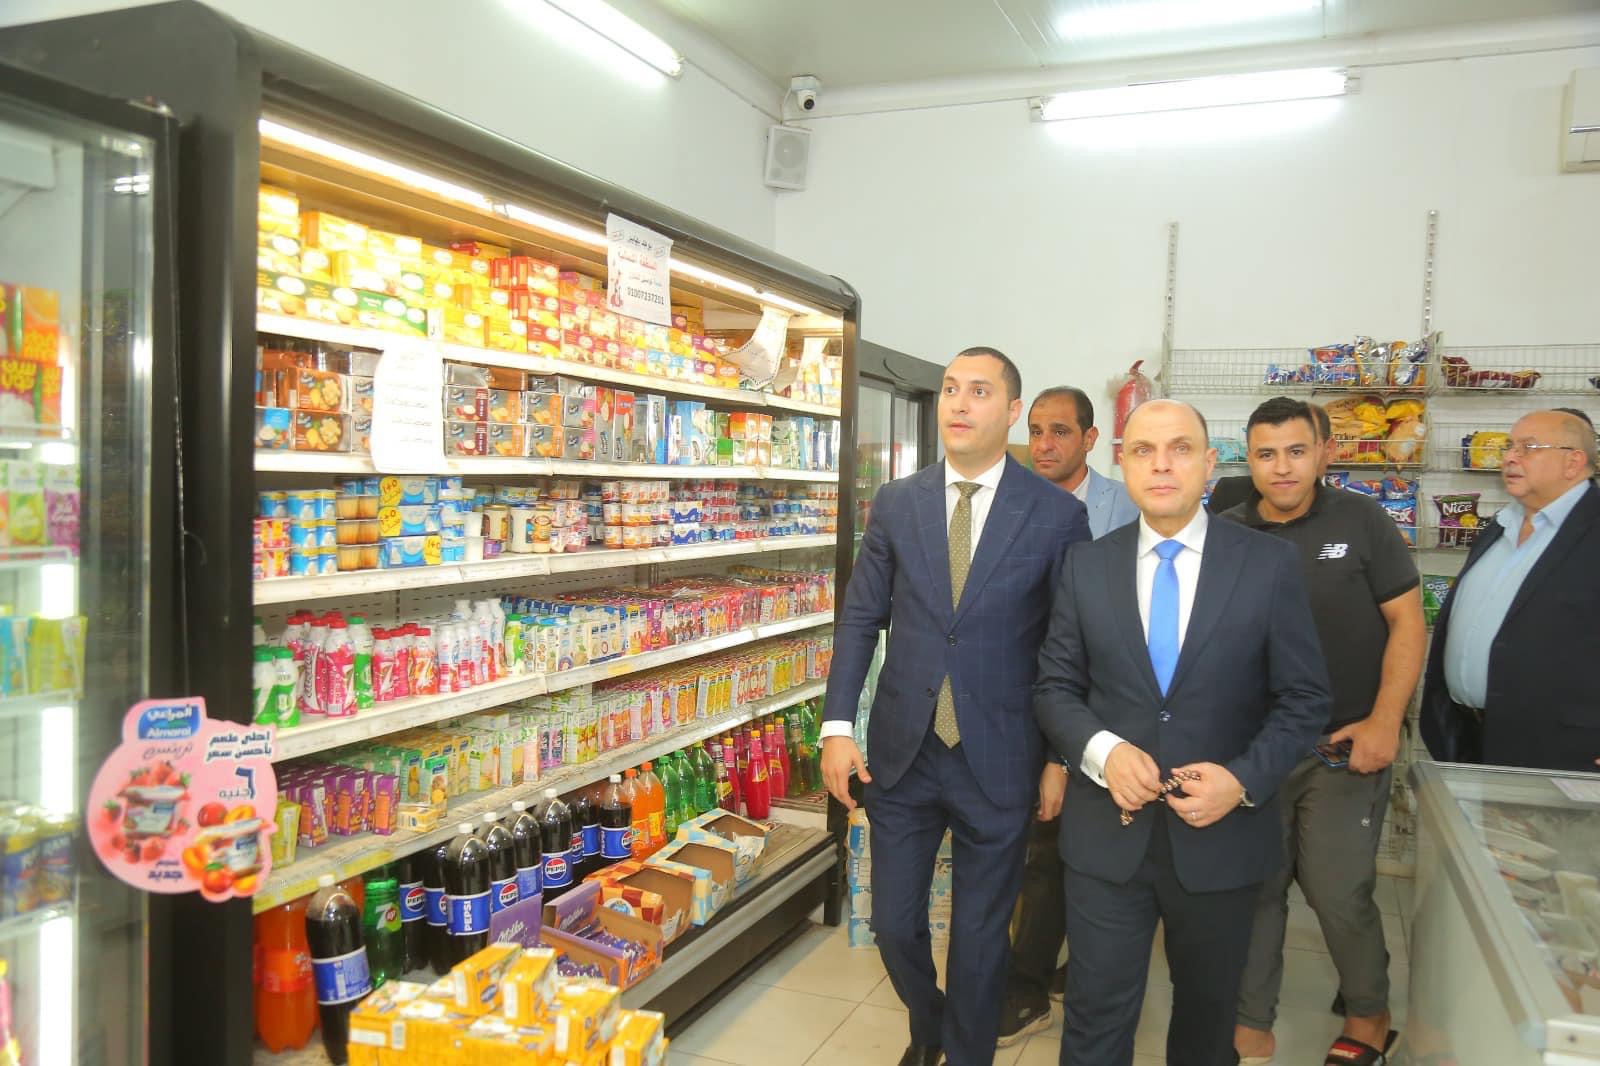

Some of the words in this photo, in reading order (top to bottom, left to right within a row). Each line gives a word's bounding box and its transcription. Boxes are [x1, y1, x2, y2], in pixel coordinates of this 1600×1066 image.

[146, 726, 193, 739] Almarai
[209, 732, 238, 747] طعم
[206, 750, 233, 763] سعر
[463, 900, 473, 931] PEPSI
